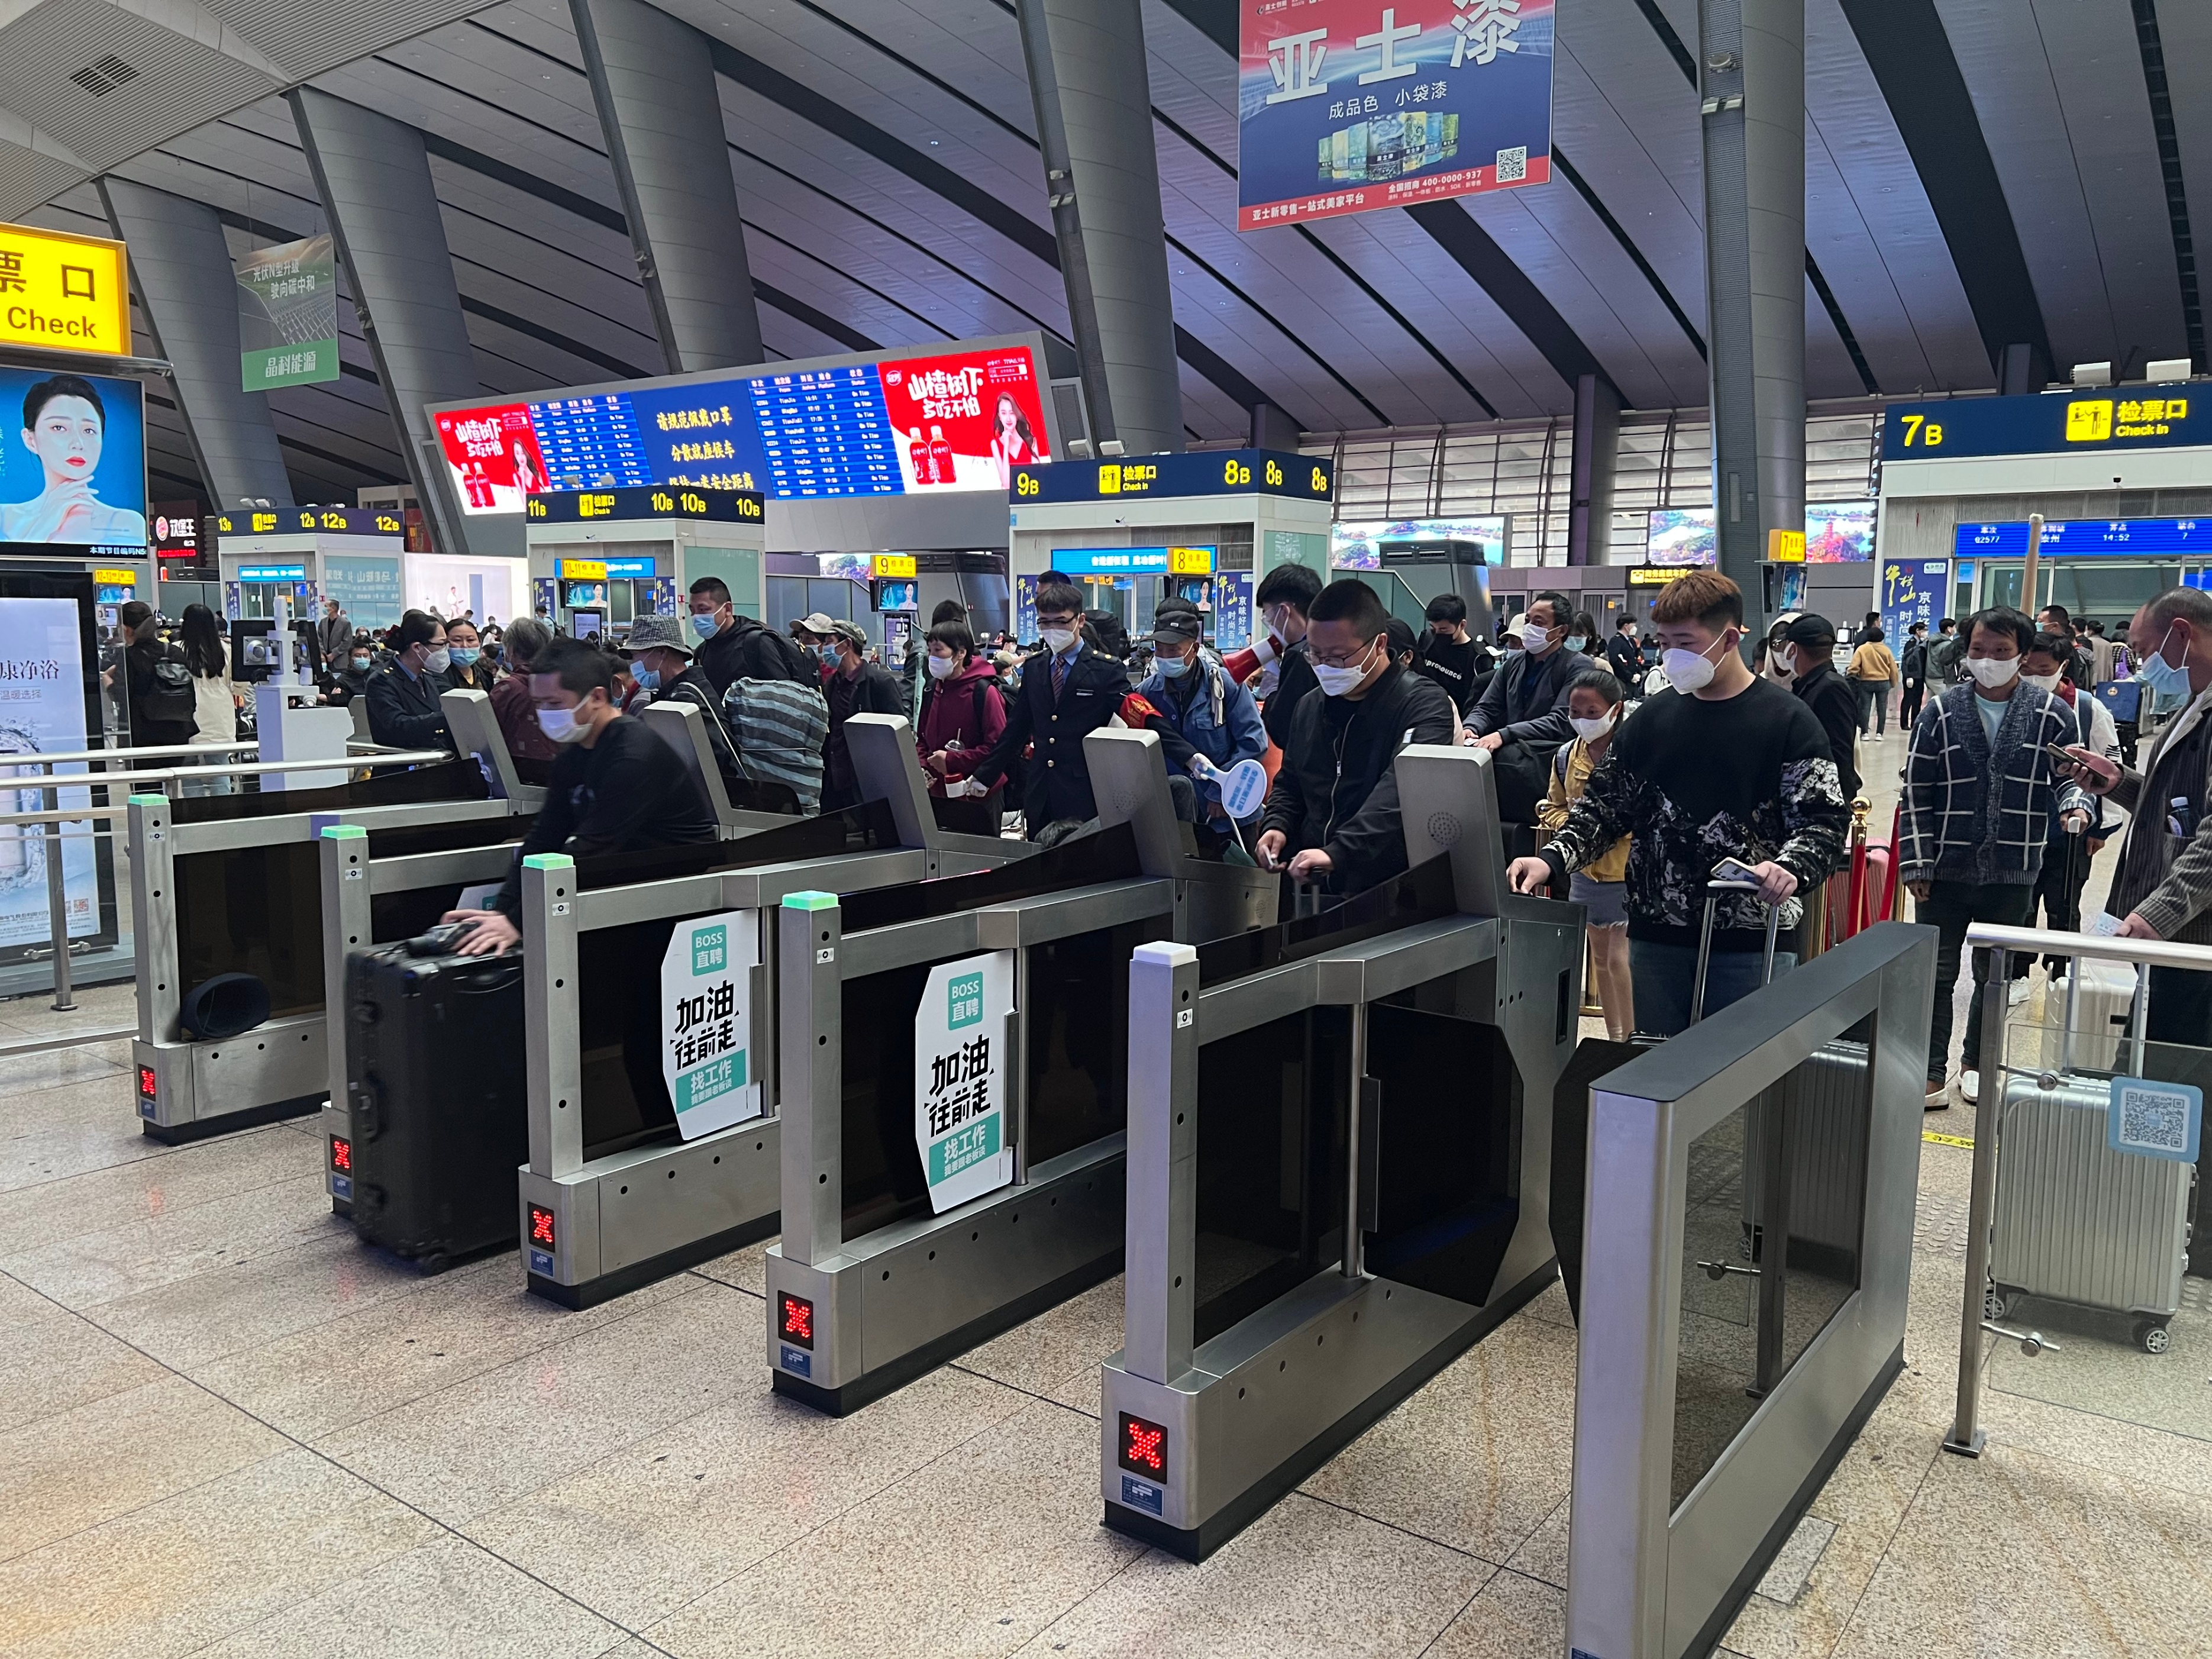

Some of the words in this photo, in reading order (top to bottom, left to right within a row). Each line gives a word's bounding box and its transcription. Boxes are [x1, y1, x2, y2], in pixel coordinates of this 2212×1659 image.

[1329, 95, 1378, 120] 成品色
[1396, 80, 1447, 108] 小袋漆
[1388, 180, 1419, 193] 全国招商
[1422, 170, 1482, 188] 400-0000-937
[1252, 193, 1364, 221] 亚士新零售一站式美家平台
[253, 258, 299, 282] 光伏N型升级
[270, 275, 315, 299] 驶向碳中和
[8, 306, 97, 339] Check
[266, 351, 316, 377] 晶科能源
[908, 366, 984, 401] 山楂树下
[657, 406, 732, 431] 请规范佩戴口罩
[922, 395, 981, 419] 多吃不怕
[2117, 400, 2187, 423] 检票口
[455, 418, 502, 443] 山楂树下
[1901, 415, 1942, 447] 7B
[2116, 425, 2153, 437] Check
[2156, 424, 2169, 435] in
[466, 440, 504, 457] 多吃不怕
[671, 440, 735, 461] 分散就座候车
[1017, 473, 1039, 495] 9B
[1123, 466, 1156, 480] 检票口
[1224, 460, 1250, 485] 8B
[1266, 460, 1282, 486] 8B
[1312, 466, 1327, 492] 8B
[1123, 482, 1141, 491] Check
[528, 499, 546, 517] 11B
[594, 495, 615, 507] 检票口
[651, 493, 673, 511] 10B
[680, 493, 706, 512] 10B
[736, 498, 760, 517] 10B
[218, 517, 232, 532] 13B
[300, 513, 315, 528] 12B
[321, 513, 347, 529] 12B
[376, 516, 399, 531] 12B
[1980, 526, 1997, 534] 车次
[2103, 533, 2130, 541] 14:52
[881, 558, 888, 573] 9
[1178, 552, 1185, 569] 8
[1238, 596, 1247, 635] 京味好酒
[1228, 611, 1236, 648] 时尚百年
[695, 932, 723, 948] BOSS
[696, 947, 723, 969] 直聘
[951, 980, 979, 999] BOSS
[674, 980, 734, 1035] 加油
[952, 998, 979, 1022] 直聘
[674, 1019, 737, 1071] 往前走
[691, 1059, 732, 1094] 找工作
[929, 1034, 990, 1098] 加油
[929, 1078, 991, 1138] 往前走
[944, 1124, 986, 1164] 找工作
